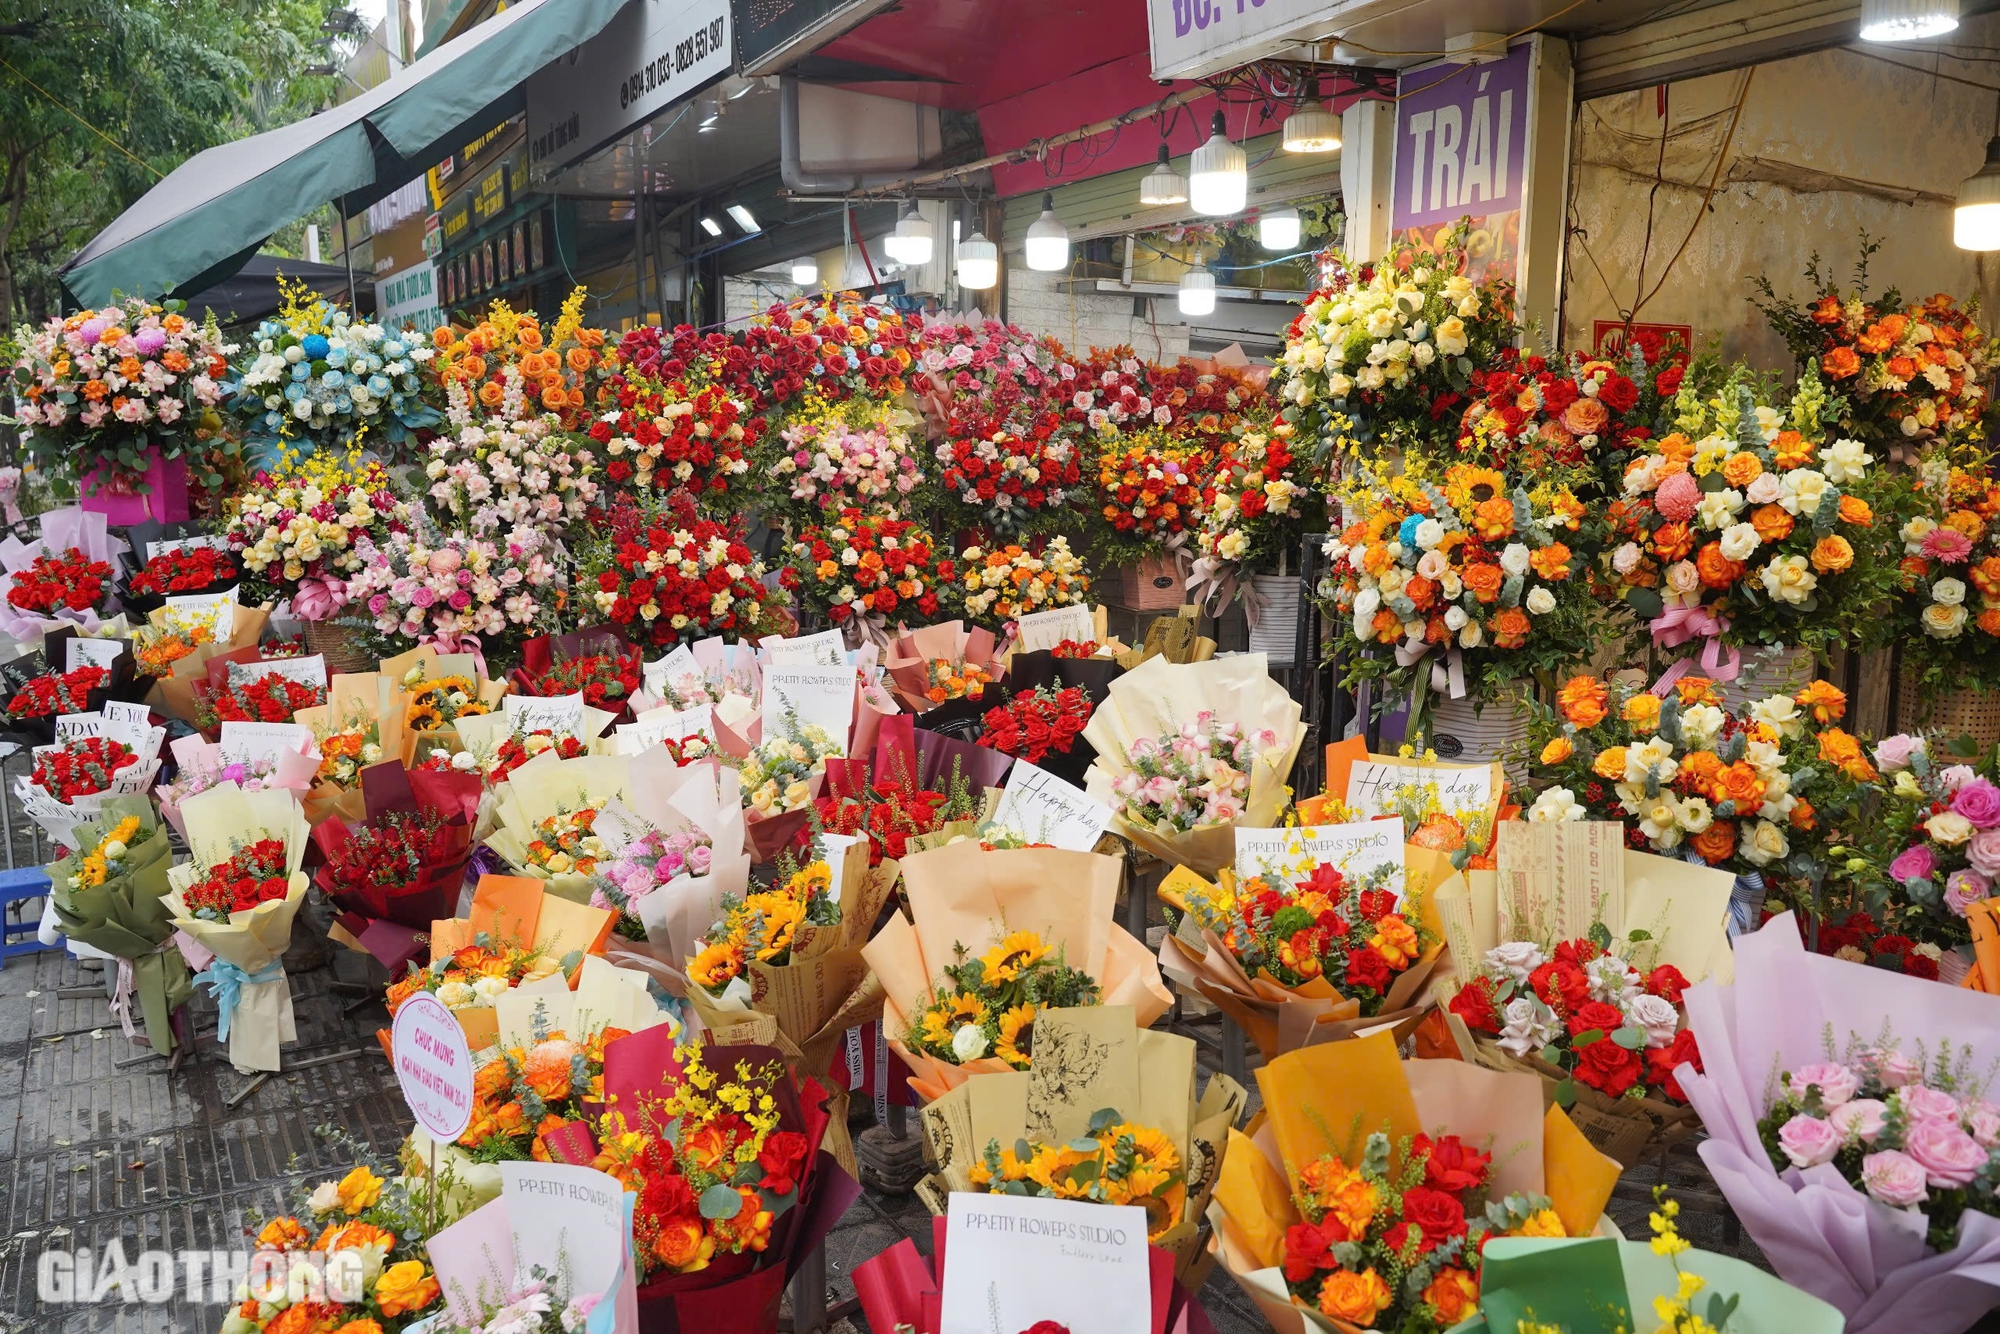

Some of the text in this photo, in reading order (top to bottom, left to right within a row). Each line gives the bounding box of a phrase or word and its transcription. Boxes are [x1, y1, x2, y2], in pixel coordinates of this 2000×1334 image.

[630, 75, 644, 103] 0914
[645, 63, 656, 94] 310
[657, 53, 670, 86] 033
[675, 36, 694, 74] 0828
[695, 27, 707, 62] 551
[709, 16, 724, 54] 987
[1410, 71, 1513, 214] TRÁI
[420, 269, 433, 296] 20K
[772, 674, 800, 684] PRETTY
[801, 675, 833, 686] FLOWERS
[511, 703, 564, 727] Happy
[1016, 771, 1100, 838] Happy day
[1247, 841, 1287, 853] PRETTY
[1347, 834, 1389, 850] STUDIO
[1590, 851, 1599, 868] DO
[1591, 878, 1599, 908] LOVE
[849, 1031, 861, 1075] MISS YOU
[877, 1093, 886, 1114] MISS
[518, 1178, 565, 1197] PRETTY
[569, 1183, 614, 1212] FLOWERS
[966, 1213, 1127, 1246] PRETTY FLOWERS STUDIO
